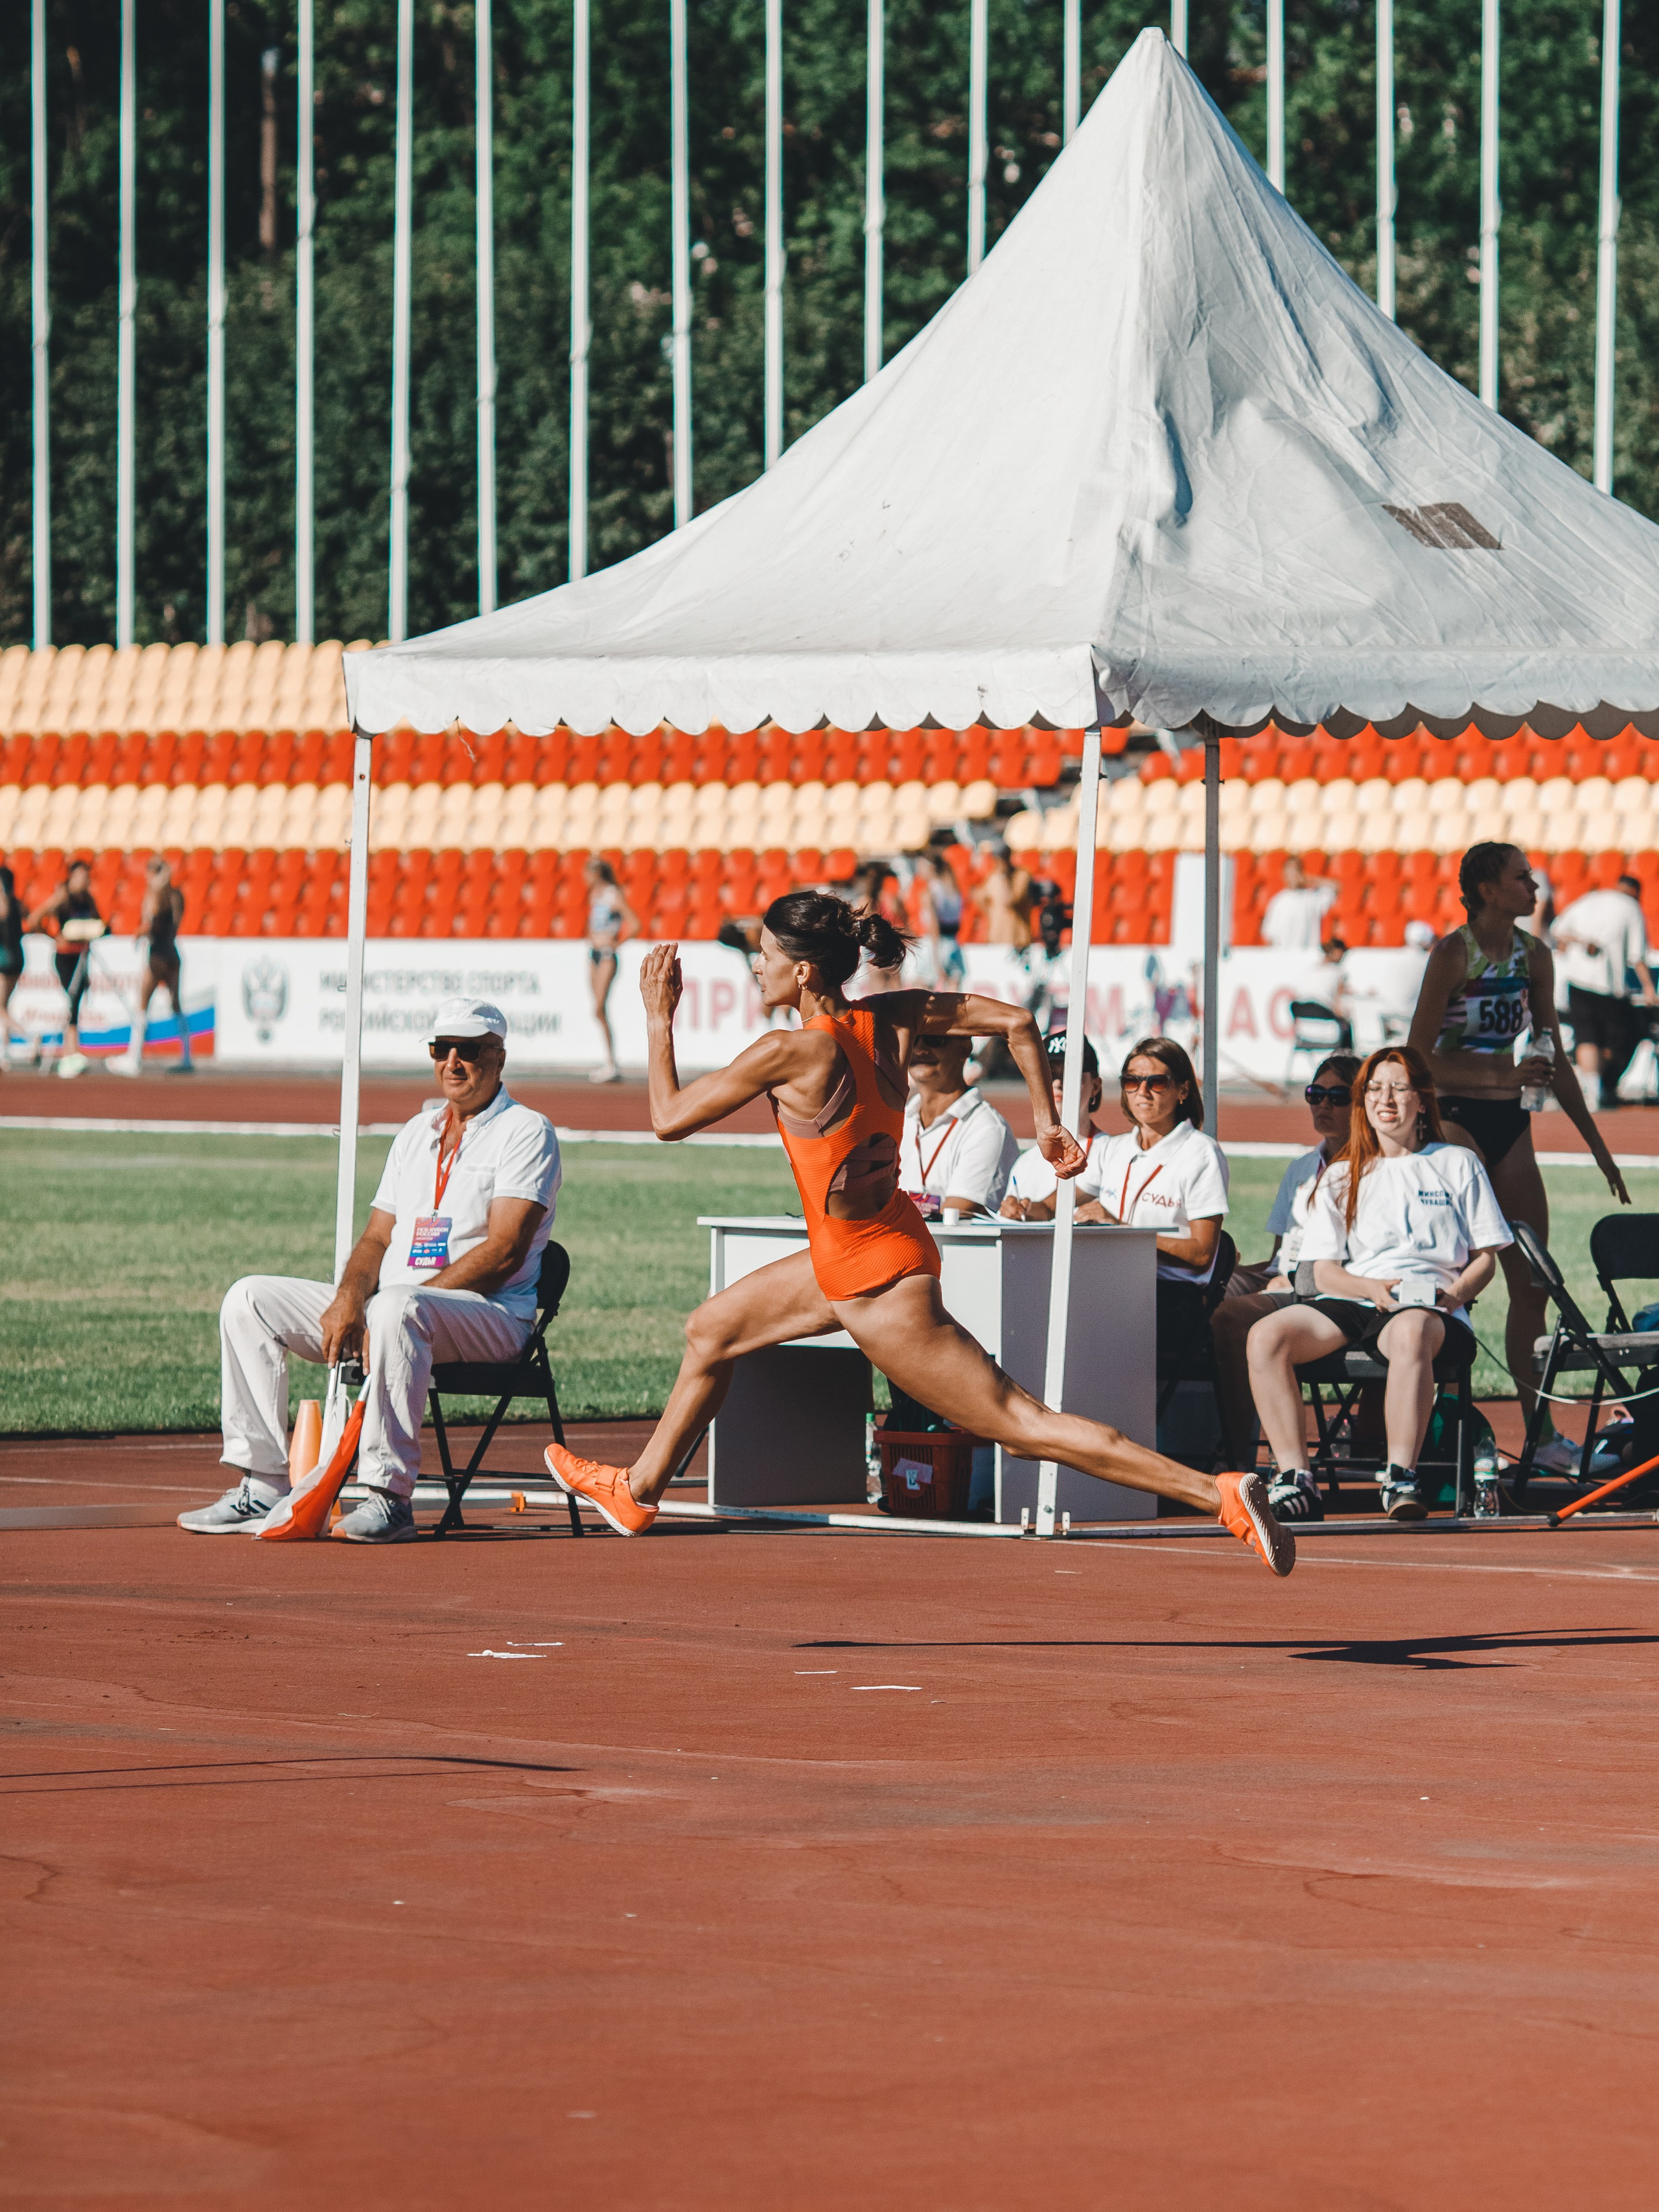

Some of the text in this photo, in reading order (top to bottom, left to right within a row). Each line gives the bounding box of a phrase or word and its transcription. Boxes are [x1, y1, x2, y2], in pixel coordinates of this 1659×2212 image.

[1479, 999, 1524, 1034] 588
[1142, 1193, 1182, 1209] СУДЬЯ
[415, 1257, 437, 1266] СУДЬЯ
